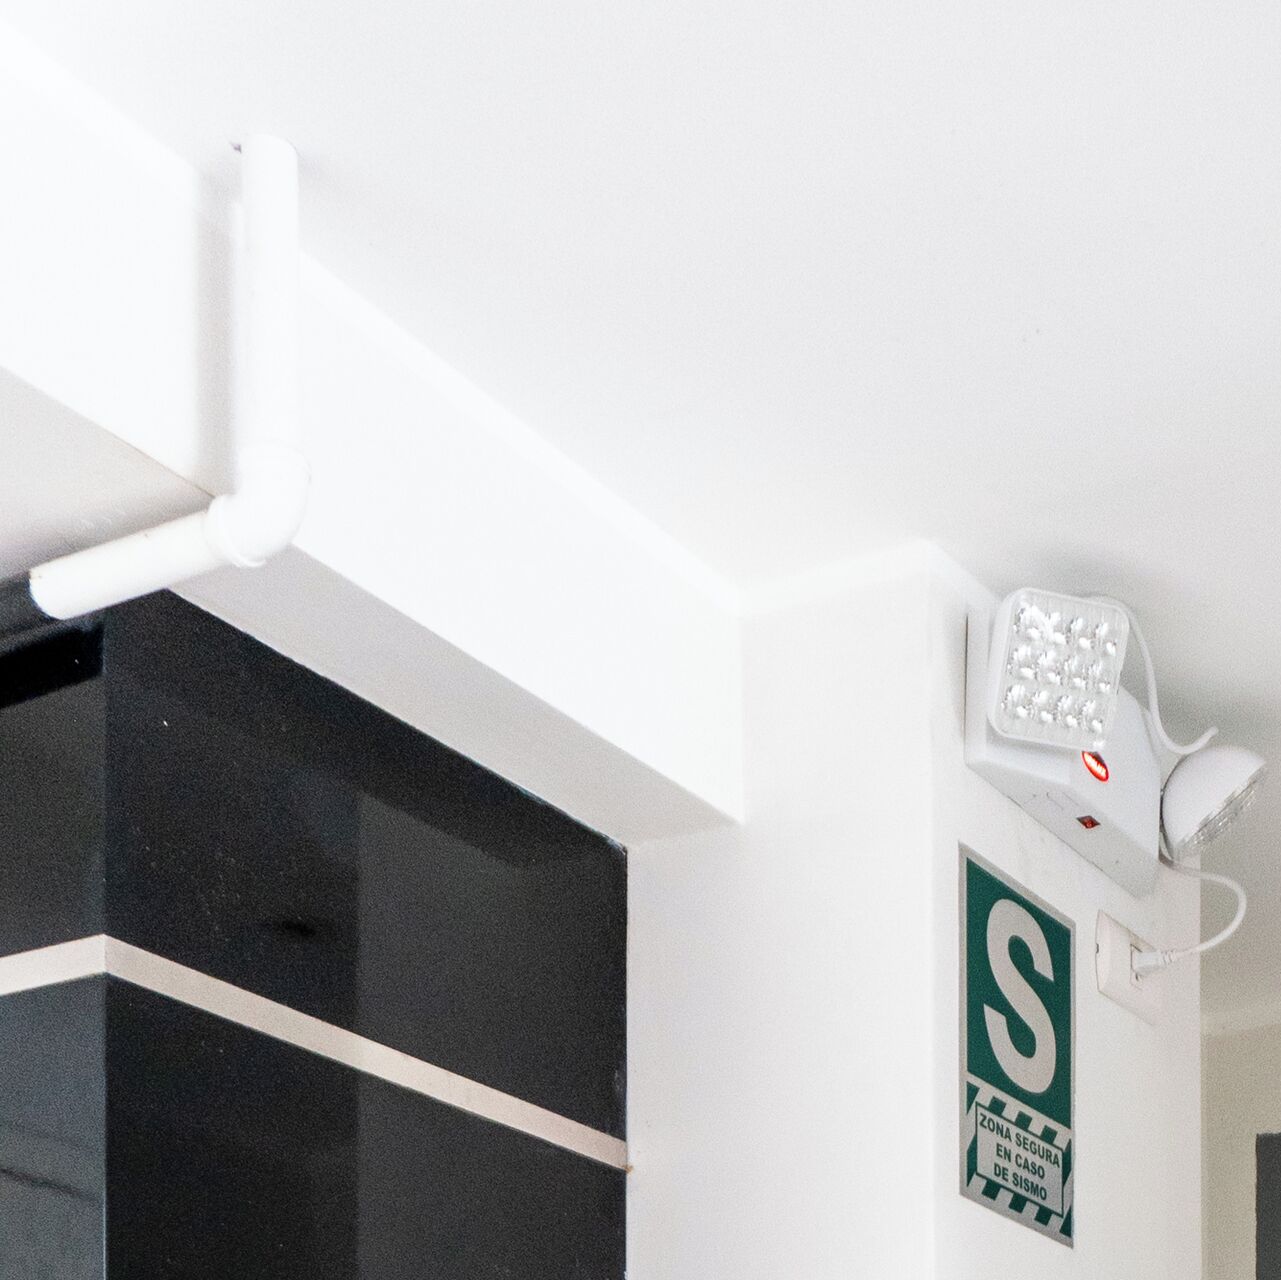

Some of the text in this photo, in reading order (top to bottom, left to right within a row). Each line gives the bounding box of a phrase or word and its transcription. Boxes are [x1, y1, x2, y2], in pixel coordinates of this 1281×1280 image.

[983, 898, 1057, 1094] S
[979, 1113, 1060, 1168] ZONA SEGURA
[996, 1142, 1045, 1179] EN CASO
[993, 1162, 1047, 1200] DE SISMO
